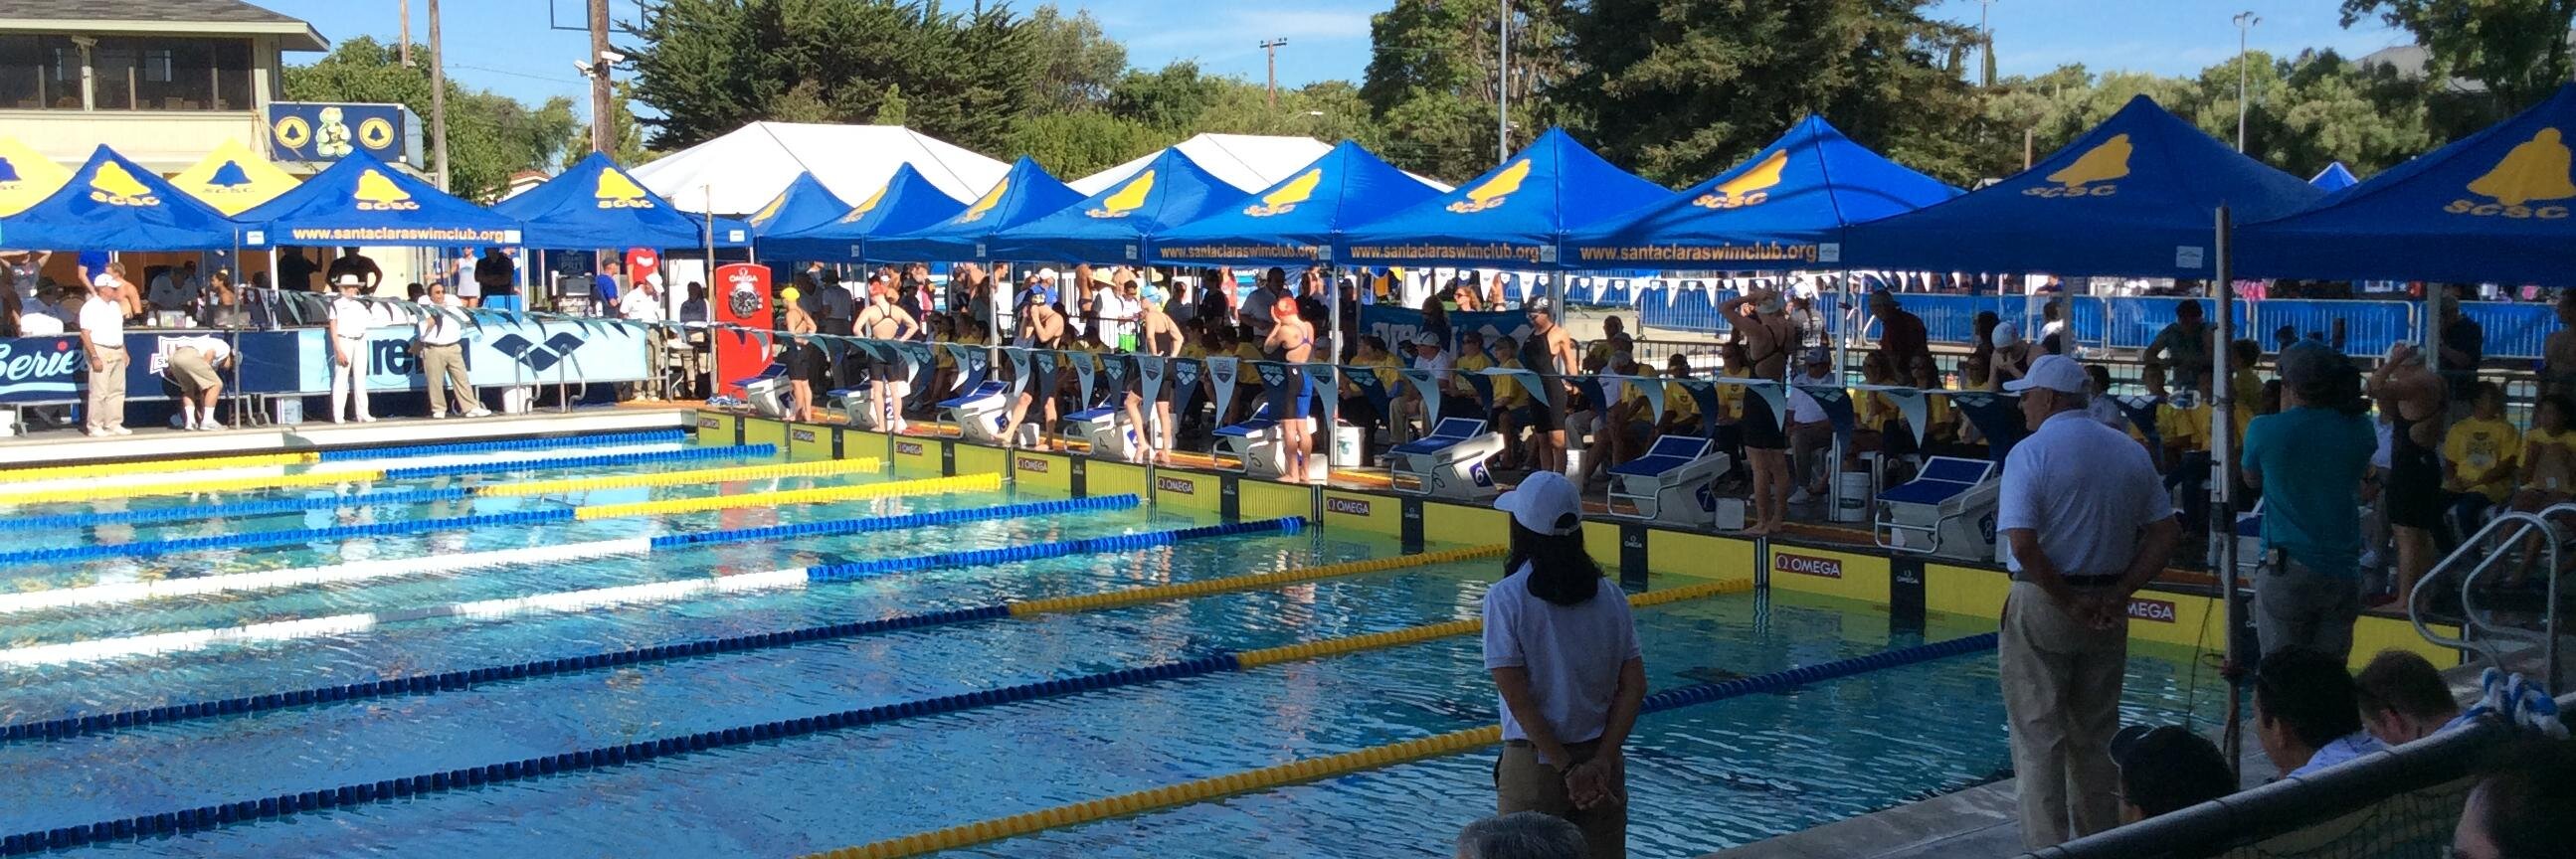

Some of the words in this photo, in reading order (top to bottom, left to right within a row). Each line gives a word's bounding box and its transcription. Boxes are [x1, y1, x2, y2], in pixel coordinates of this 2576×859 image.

[2021, 185, 2117, 198] SCSC
[1692, 192, 1768, 209] SCSC
[2443, 200, 2570, 219] SCSC
[293, 227, 505, 244] www.santaclaraswimclub.org
[1161, 244, 1318, 260] www.santaclaraswimclub.org
[1351, 243, 1541, 261] www.santaclaraswimclub.org
[1579, 241, 1817, 261] www.santaclaraswimclub.org
[886, 407, 894, 420] 2
[1025, 460, 1047, 471] OMEGA
[1475, 466, 1484, 483] 6
[1166, 480, 1194, 492] OMEGA
[1337, 501, 1370, 514] OMEGA
[1703, 490, 1712, 508] 7
[1791, 558, 1840, 576] OMEGA
[2127, 601, 2174, 620] MEGA
